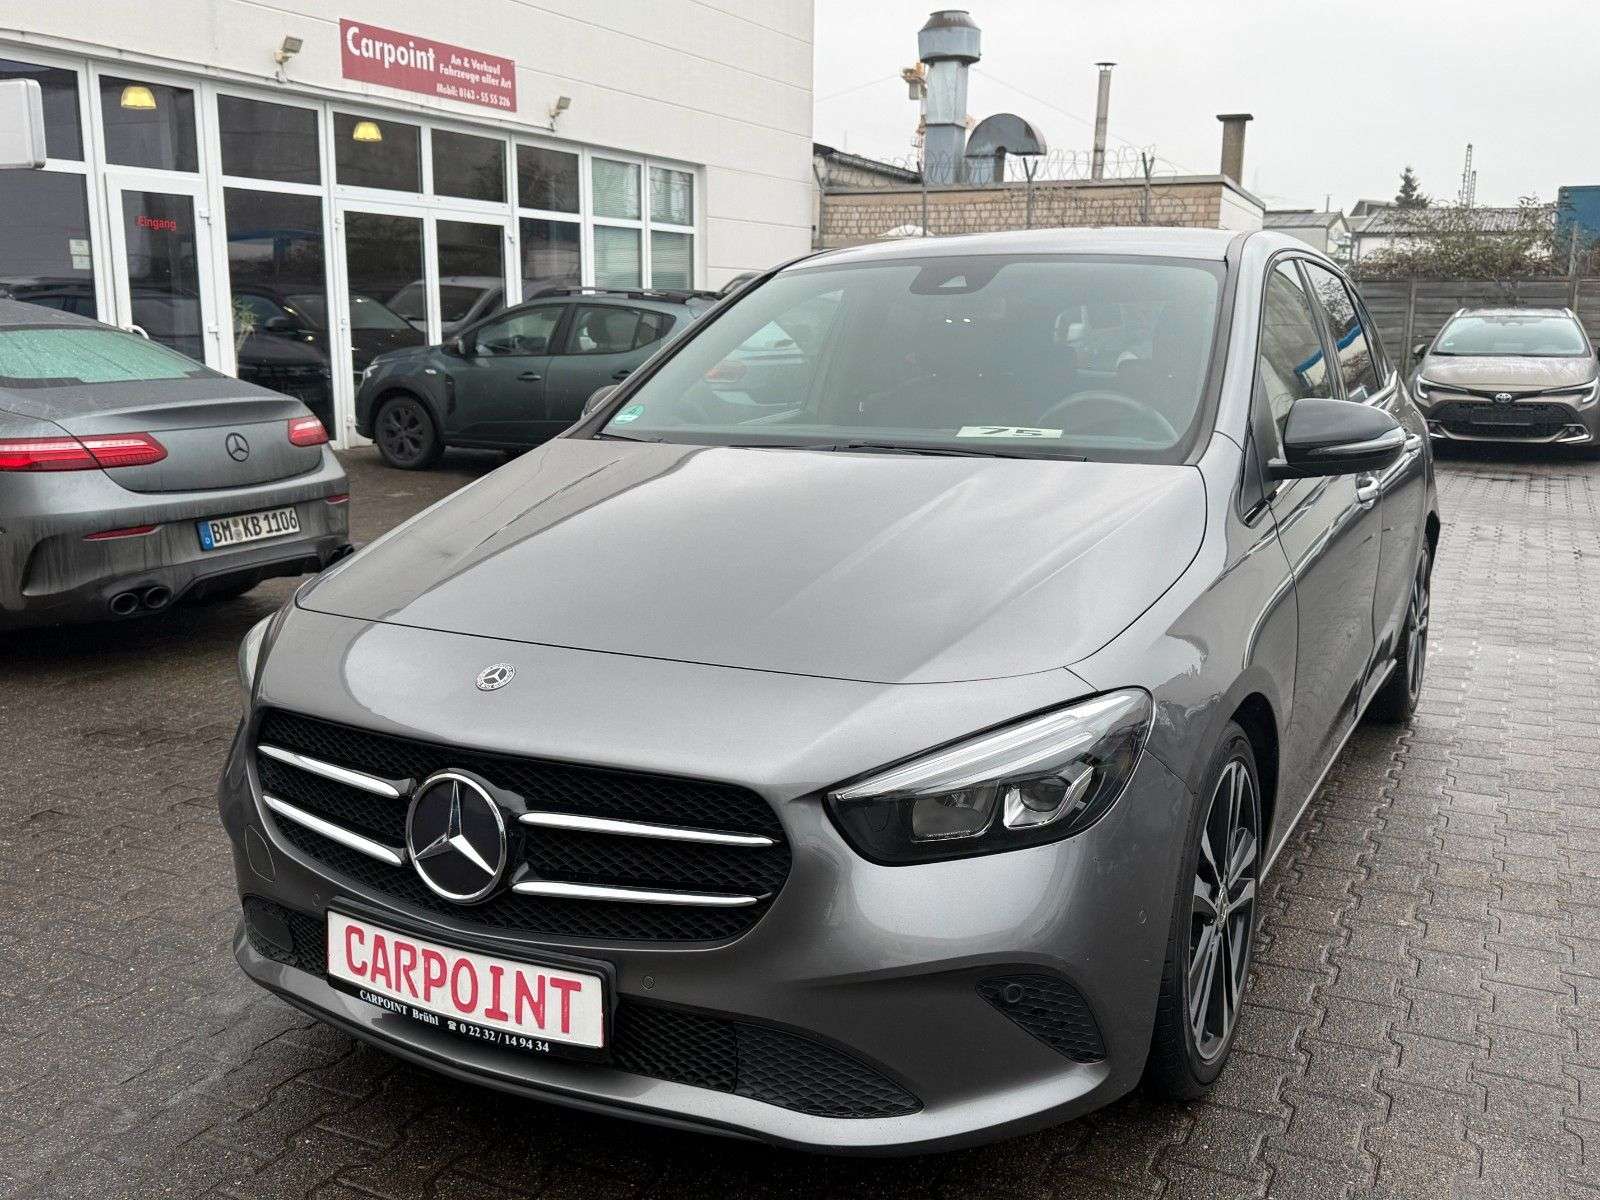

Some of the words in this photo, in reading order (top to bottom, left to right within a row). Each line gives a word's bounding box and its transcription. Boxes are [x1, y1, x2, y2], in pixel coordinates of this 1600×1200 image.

[346, 26, 435, 72] Carpoint
[451, 54, 462, 66] An
[463, 56, 470, 68] &
[471, 58, 501, 75] Verkauf
[440, 63, 480, 84] Fahrzeuge
[481, 74, 499, 86] aller
[501, 77, 512, 88] Art
[136, 215, 177, 232] Eingang
[211, 520, 234, 544] BM
[242, 516, 263, 538] KB
[264, 510, 297, 533] 1106
[345, 924, 582, 1034] CARPOINT
[359, 989, 407, 1015] CARPOINT
[412, 1007, 440, 1026] Brühl
[459, 1022, 467, 1034] 0
[468, 1025, 481, 1038] 22
[483, 1029, 496, 1042] 32
[504, 1034, 518, 1046] 14
[519, 1037, 534, 1050] 94
[535, 1039, 550, 1053] 34
